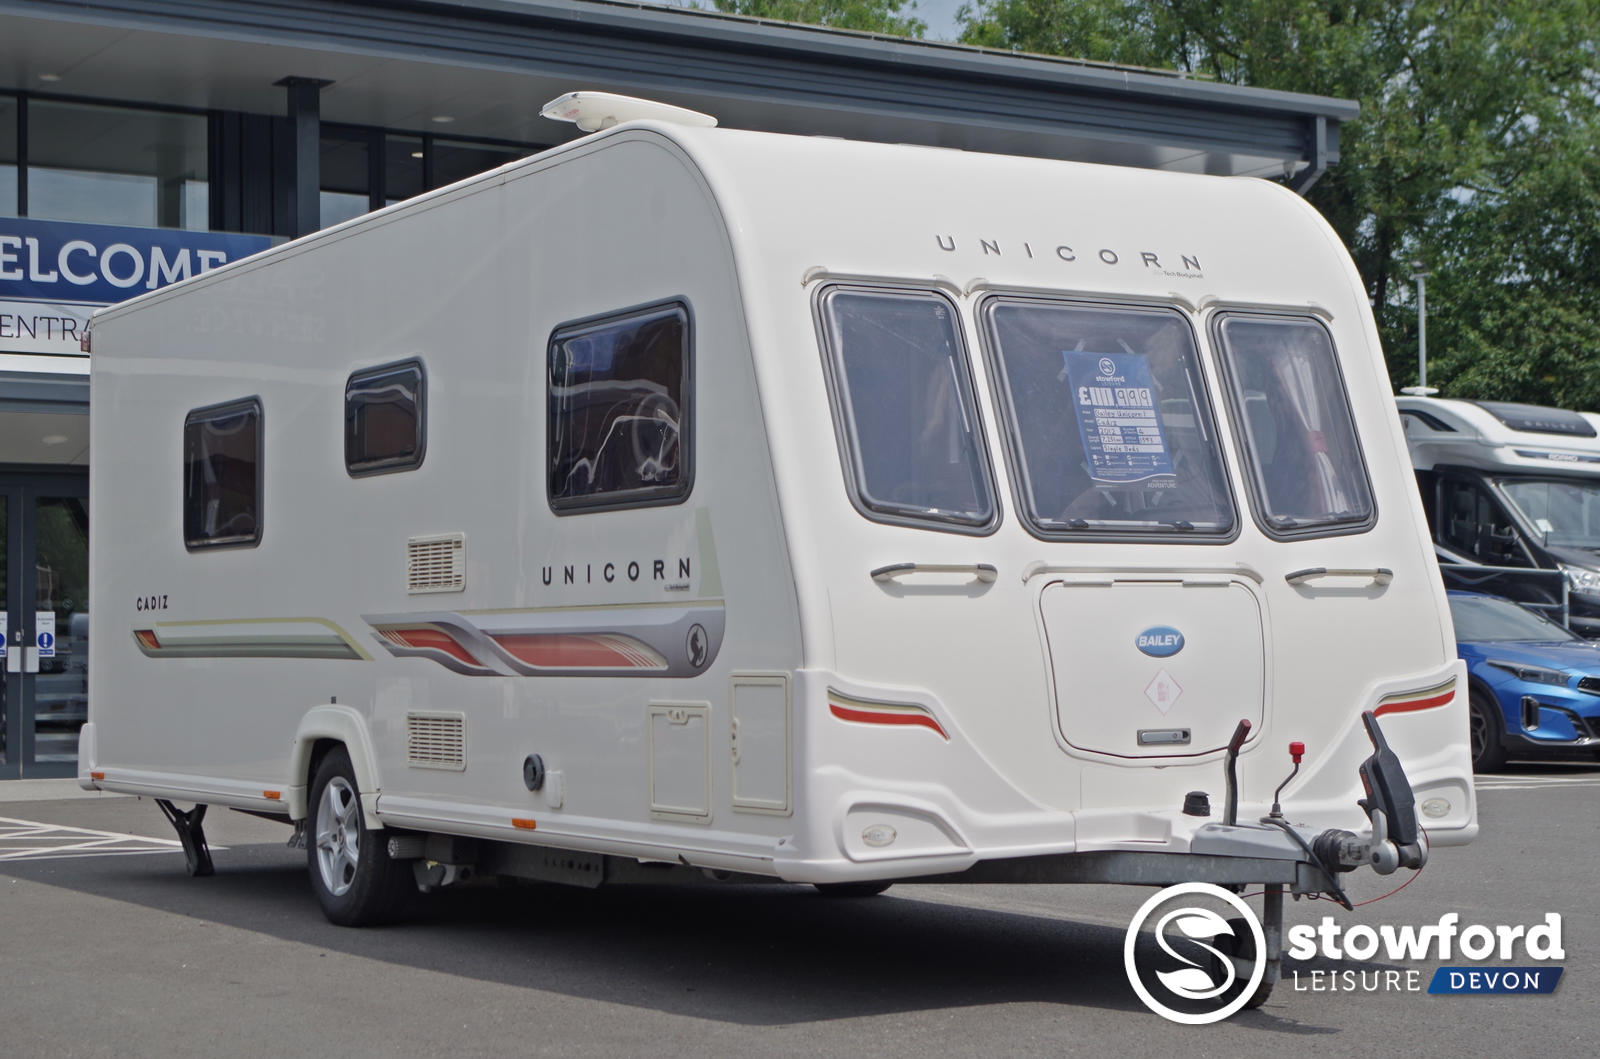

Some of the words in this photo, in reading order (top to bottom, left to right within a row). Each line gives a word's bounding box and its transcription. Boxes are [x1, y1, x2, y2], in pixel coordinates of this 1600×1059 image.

[936, 235, 1202, 270] UNICORN
[542, 557, 690, 586] UNICORN
[136, 594, 168, 611] CADIZ
[1138, 634, 1181, 647] BAILEY
